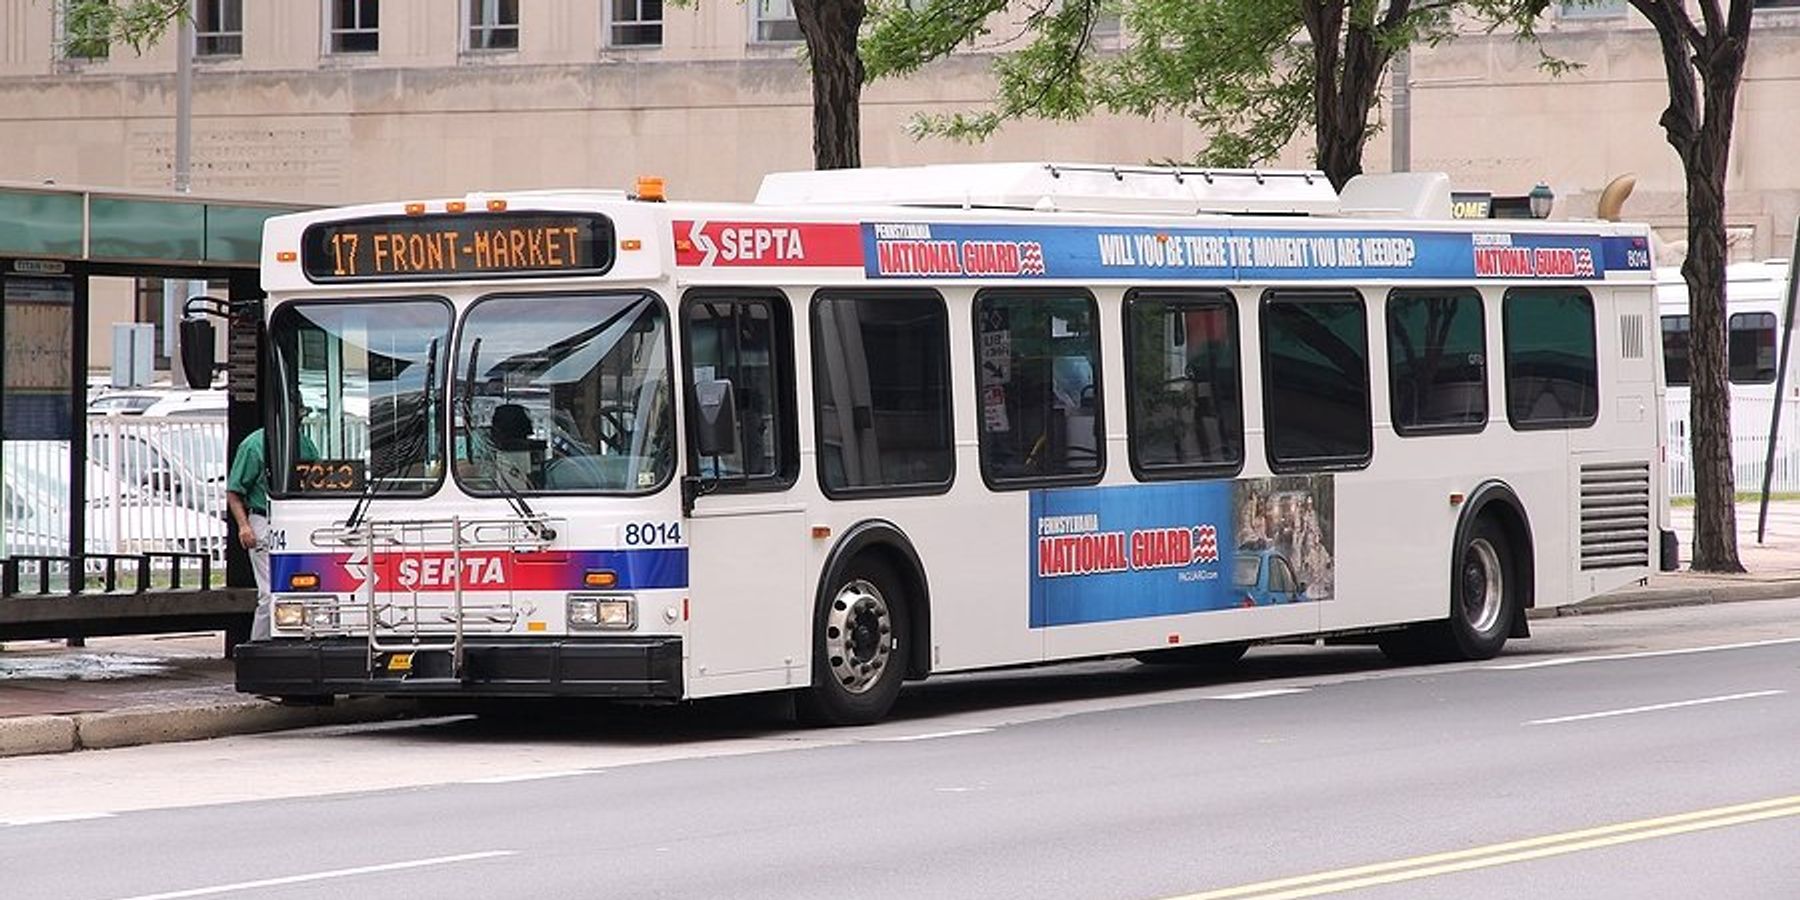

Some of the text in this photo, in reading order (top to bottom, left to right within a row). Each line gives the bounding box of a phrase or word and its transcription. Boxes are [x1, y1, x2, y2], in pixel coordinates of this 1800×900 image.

[332, 227, 579, 276] 17 FRONT-MARKET
[720, 228, 805, 261] SEPTA
[877, 240, 1020, 276] NATIONAL GUARD
[1098, 233, 1416, 267] WILL YOU BE THERE THE MOMENT YOU ARE NEEDED?
[1627, 249, 1649, 267] 8014
[1474, 248, 1576, 277] NATIONAL GUARD
[625, 523, 681, 545] 8014
[1038, 514, 1099, 535] PENNSYLVANIA
[1039, 527, 1193, 577] NATIONAL GUARD
[398, 557, 505, 587] SEPTA
